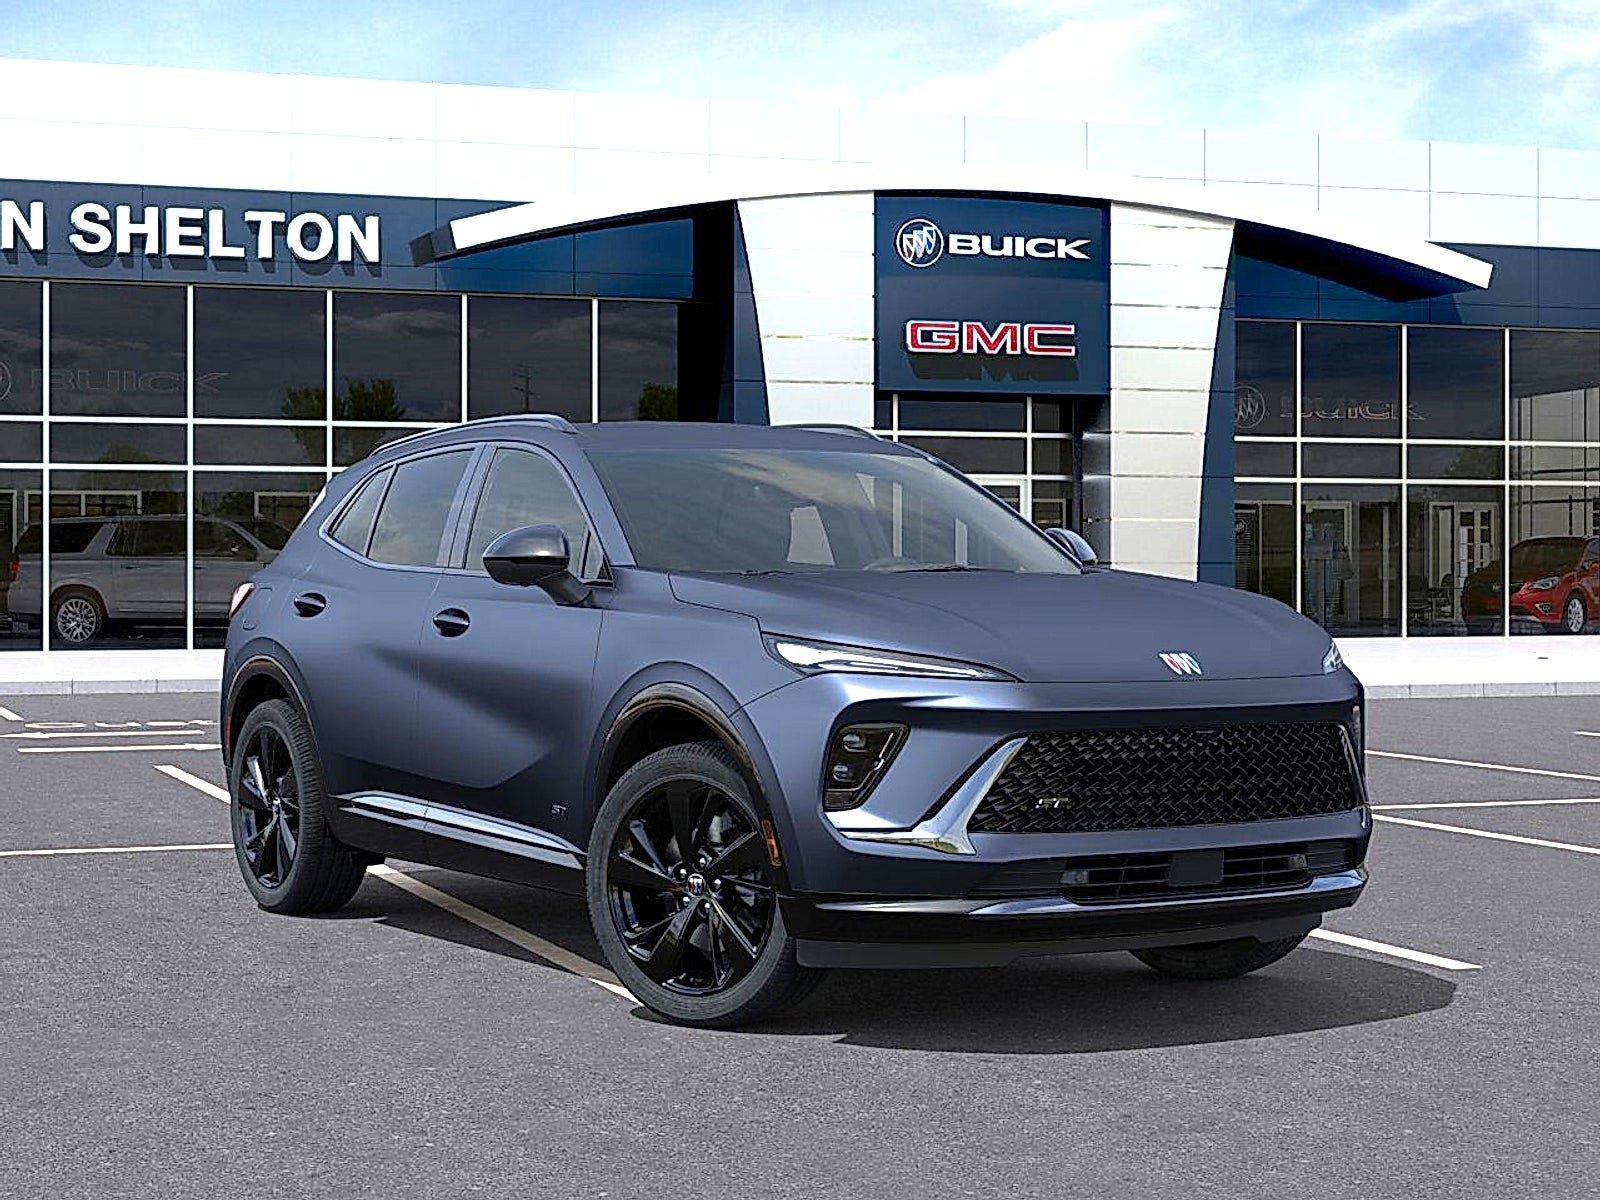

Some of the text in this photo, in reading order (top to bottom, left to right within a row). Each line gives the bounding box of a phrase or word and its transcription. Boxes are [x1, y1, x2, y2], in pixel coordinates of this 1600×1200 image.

[1, 200, 380, 263] N SHELTON
[948, 233, 1092, 260] BUICK
[906, 319, 1076, 356] GMC
